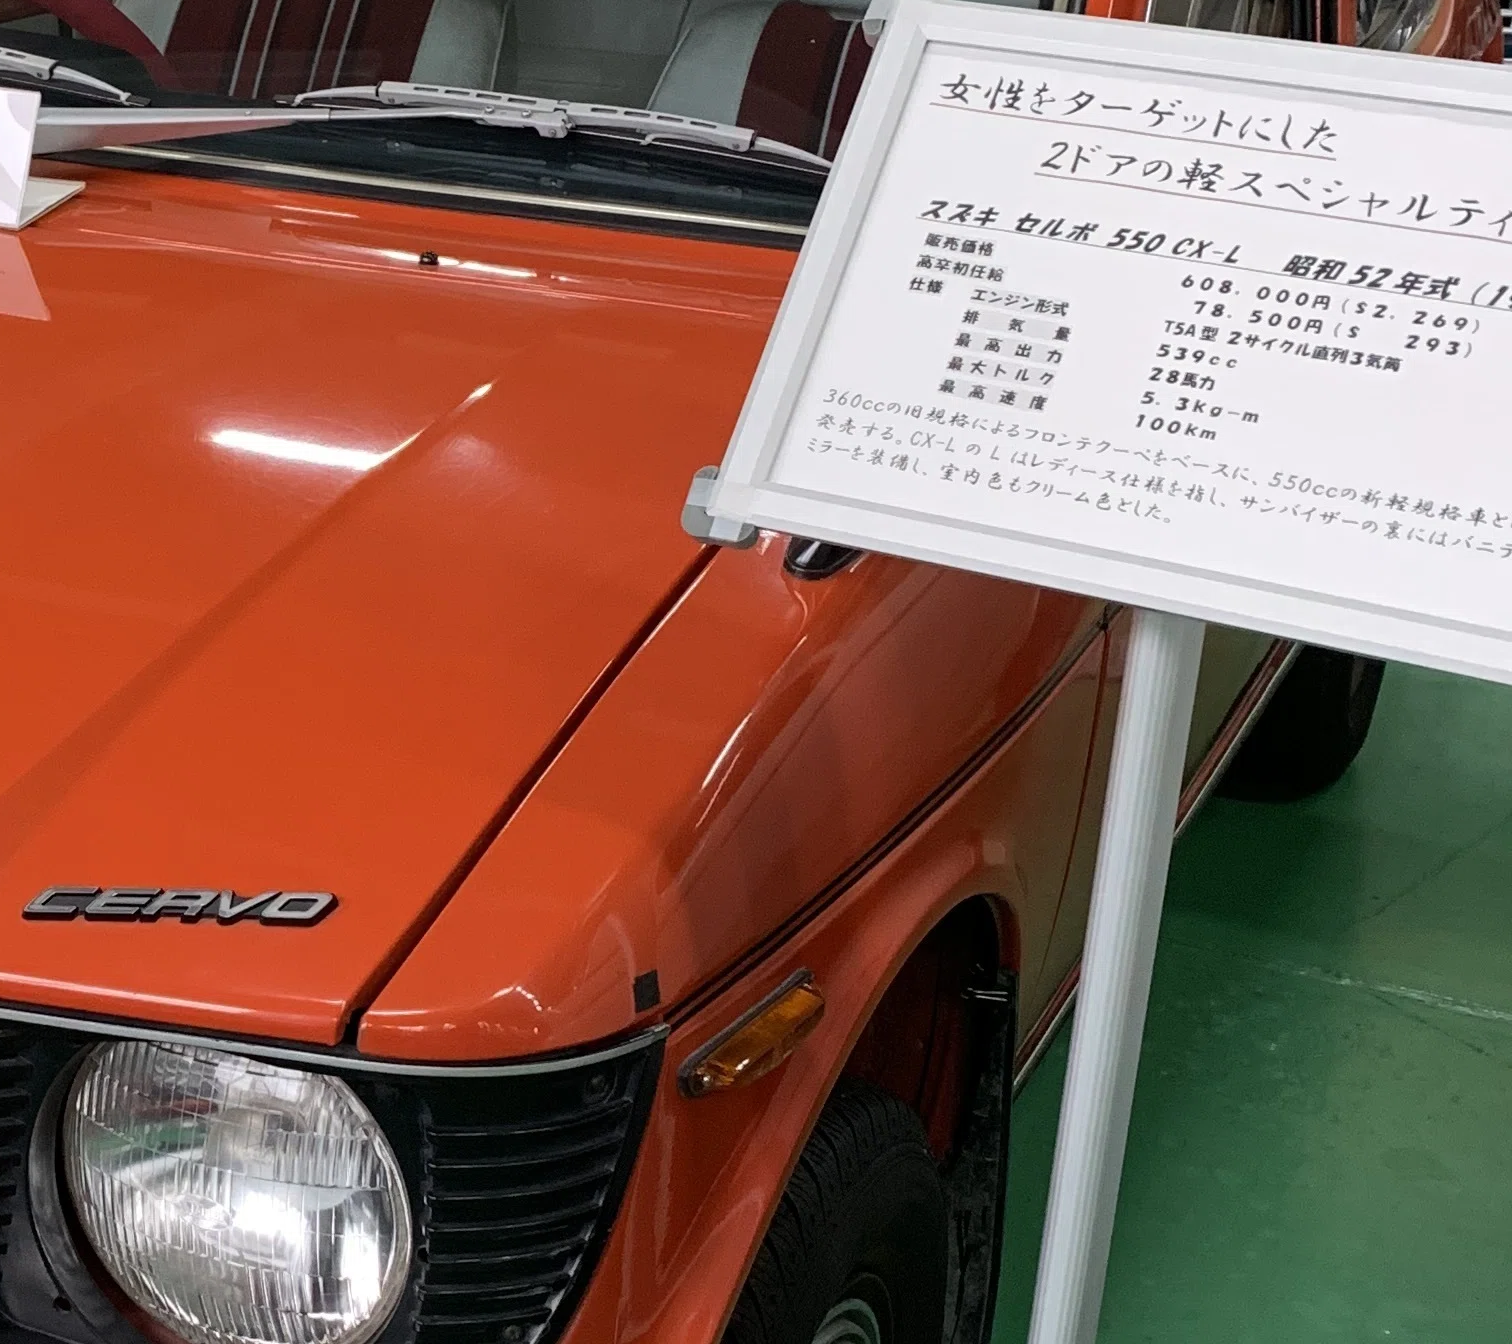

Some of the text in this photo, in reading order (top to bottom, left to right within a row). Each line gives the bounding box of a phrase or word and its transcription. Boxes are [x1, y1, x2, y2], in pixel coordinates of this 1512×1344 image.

[939, 73, 1337, 153] 女性をターゲットにした
[921, 200, 999, 227] スズキ
[1014, 212, 1099, 242] セルボ
[1106, 228, 1167, 253] 550
[1172, 239, 1241, 265] CX-L
[925, 233, 995, 257] 販売価格
[915, 253, 1005, 283] 高卒初任給
[909, 276, 1070, 317] 仕様 エンジン形式
[1156, 343, 1238, 370] 539cc
[1148, 367, 1216, 391] 28馬力
[1135, 414, 1218, 441] 100km
[822, 388, 1512, 530] 360ccの旧規格によるフロンテクーペをベースに、550ccの新軽規格車と
[22, 887, 338, 928] CERVO
